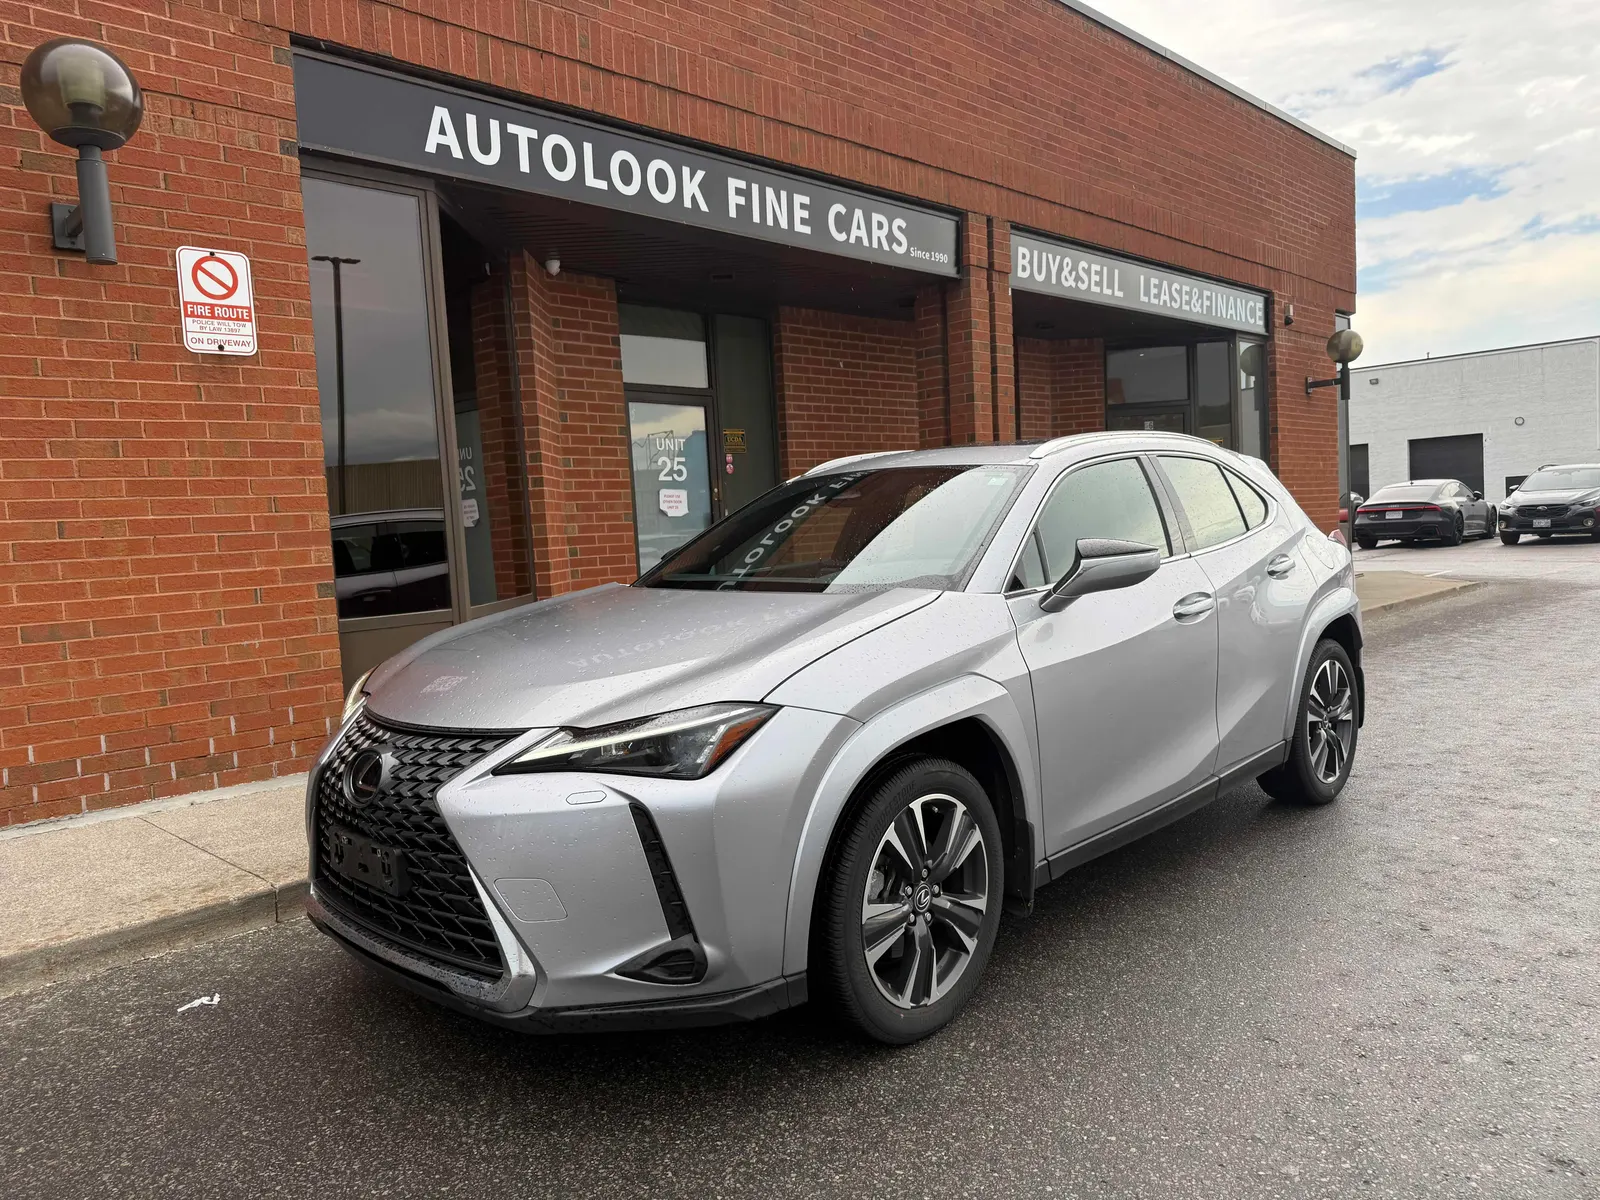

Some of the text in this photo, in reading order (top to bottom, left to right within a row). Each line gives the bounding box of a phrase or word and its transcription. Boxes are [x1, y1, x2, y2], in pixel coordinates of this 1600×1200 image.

[424, 105, 908, 255] AUTOLOOK FINE CARS
[910, 247, 949, 264] Since 1990
[1017, 246, 1264, 326] BUY&SELL LEASE&FINANCE
[187, 304, 250, 320] FIRE ROUTE
[190, 337, 252, 348] ON DRIVEWAY
[656, 438, 686, 451] UNIT
[657, 456, 688, 482] 25
